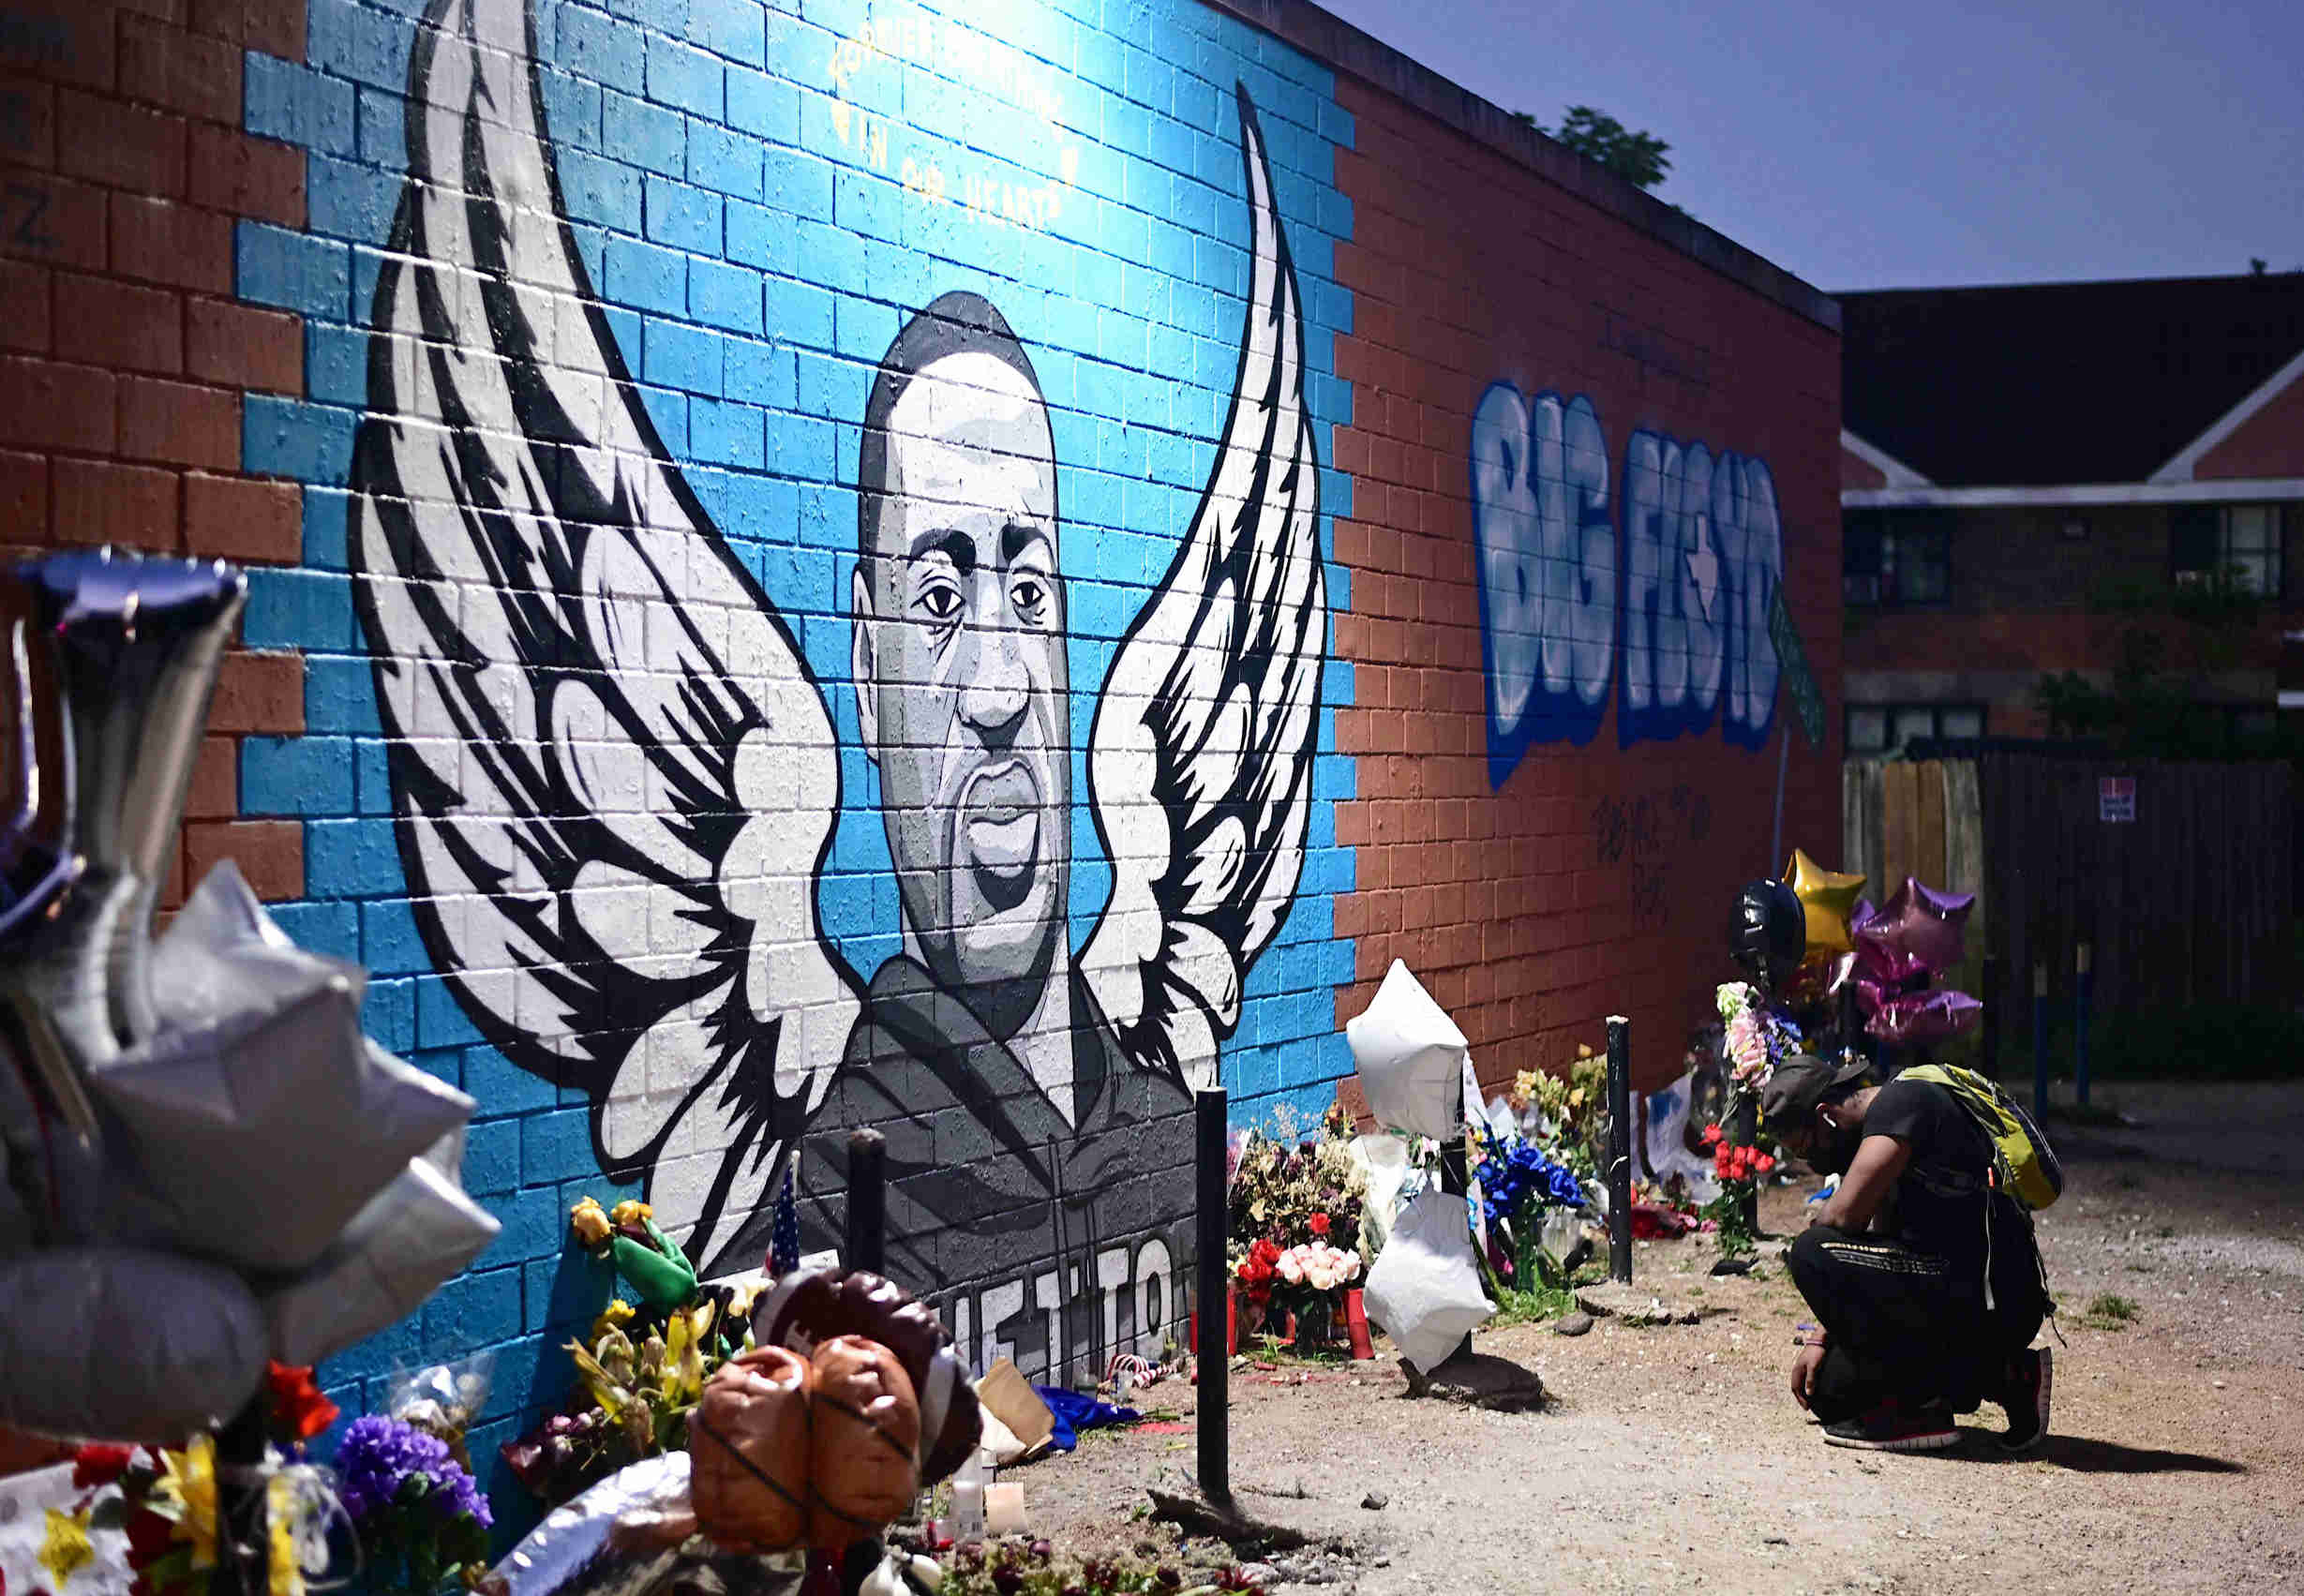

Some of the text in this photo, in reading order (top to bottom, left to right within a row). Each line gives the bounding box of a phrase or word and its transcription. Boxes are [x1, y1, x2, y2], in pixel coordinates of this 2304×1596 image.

[859, 113, 889, 172] IN
[1472, 379, 1783, 757] BIG FLOYD
